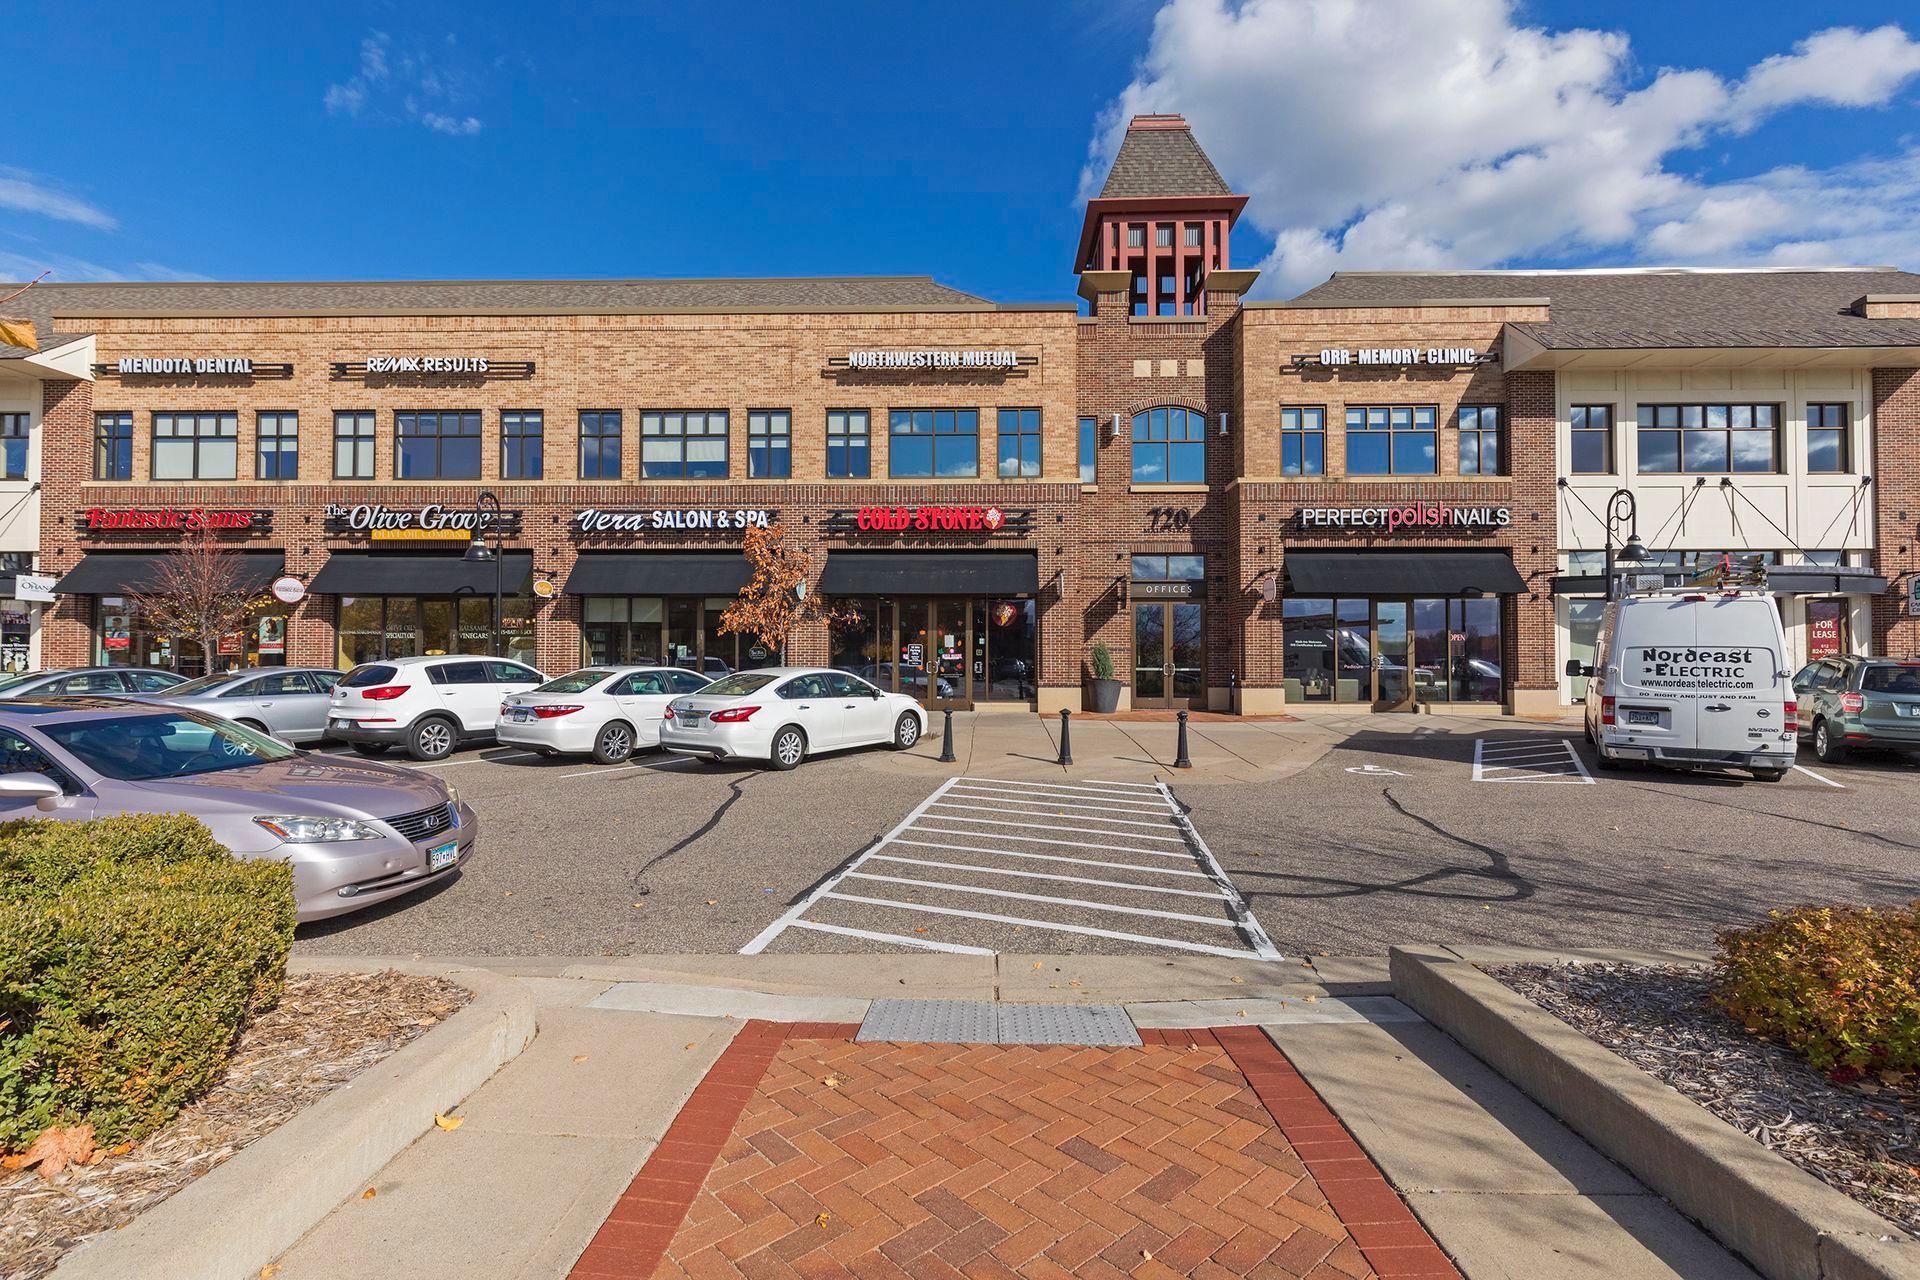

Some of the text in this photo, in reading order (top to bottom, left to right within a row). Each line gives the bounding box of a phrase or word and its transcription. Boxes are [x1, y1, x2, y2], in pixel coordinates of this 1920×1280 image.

[367, 357, 488, 372] RE/MAX RESULTS
[849, 351, 1018, 367] NORTHWESTERN MUTUAL
[1320, 348, 1476, 365] ORR MEMORY CLINIC
[119, 358, 252, 373] MENDOTA DENTAL
[84, 506, 254, 531] Fantastic Sams
[325, 504, 491, 530] The Olive Grove
[577, 508, 768, 532] Vera SALON & SPA
[857, 507, 982, 530] COLD STONE
[1302, 501, 1510, 533] PERFECT polish NAILS
[1146, 585, 1193, 593] OFFICES
[1815, 620, 1833, 629] FOR
[1812, 630, 1837, 639] LEASE
[1642, 647, 1752, 664] Nordeast
[1655, 662, 1745, 678] ELECTRIC
[1641, 679, 1754, 689] www.nordeastelectric.com
